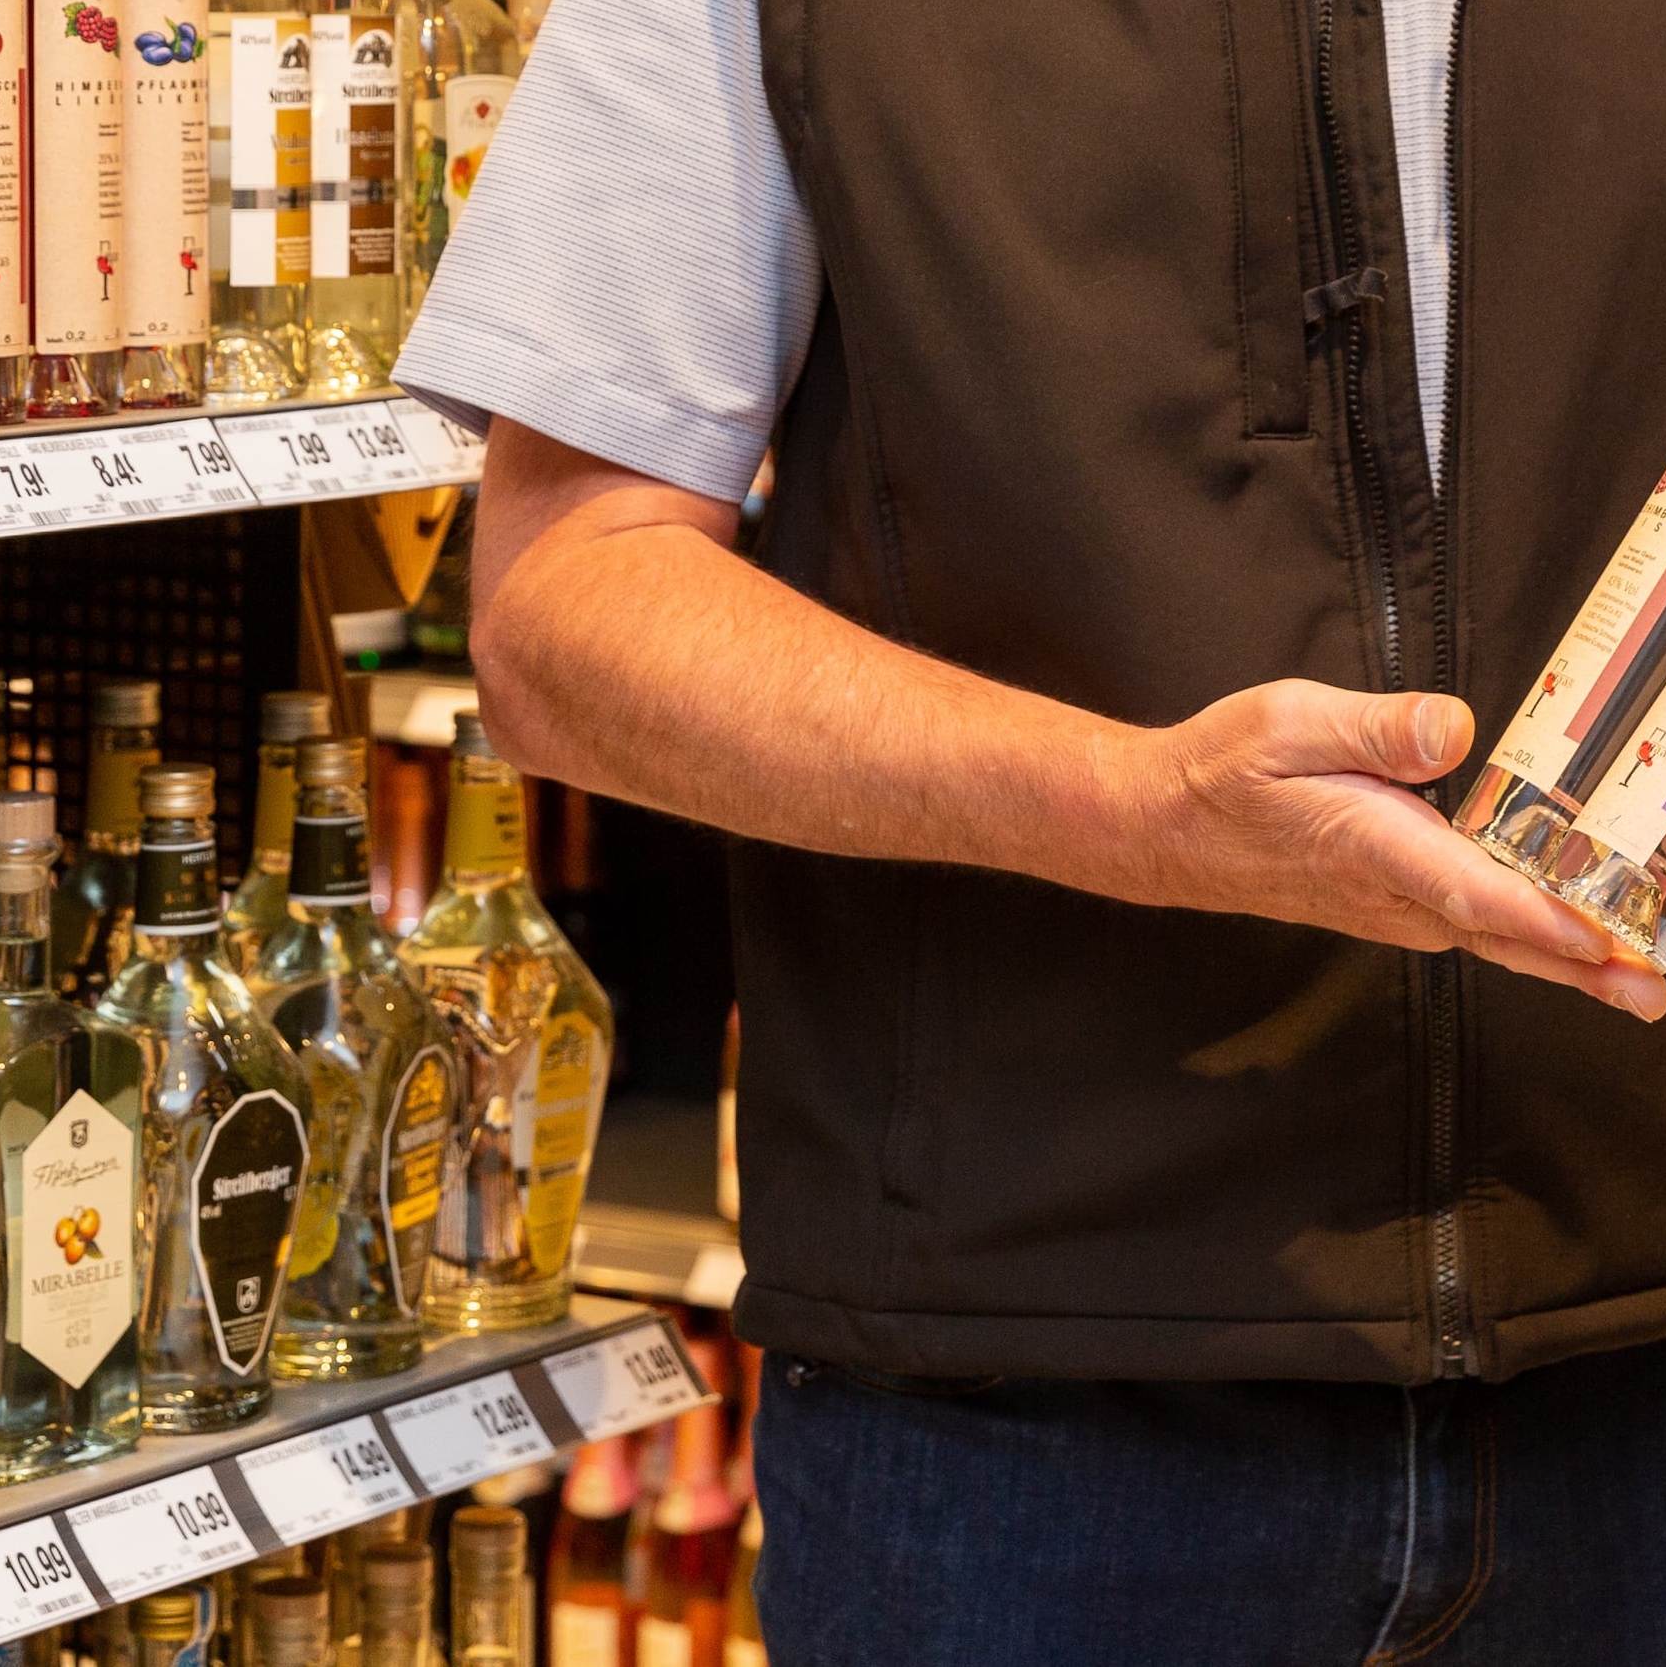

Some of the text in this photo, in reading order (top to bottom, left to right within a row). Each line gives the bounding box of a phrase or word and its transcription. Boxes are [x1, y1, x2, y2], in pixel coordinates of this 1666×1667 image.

[179, 439, 232, 477] 7.99
[280, 432, 332, 467] 7.99
[32, 1259, 124, 1296] MIRABELLE
[331, 1439, 391, 1486] 14.99
[166, 1490, 231, 1541] 10.99
[4, 1541, 74, 1595] 10.99
